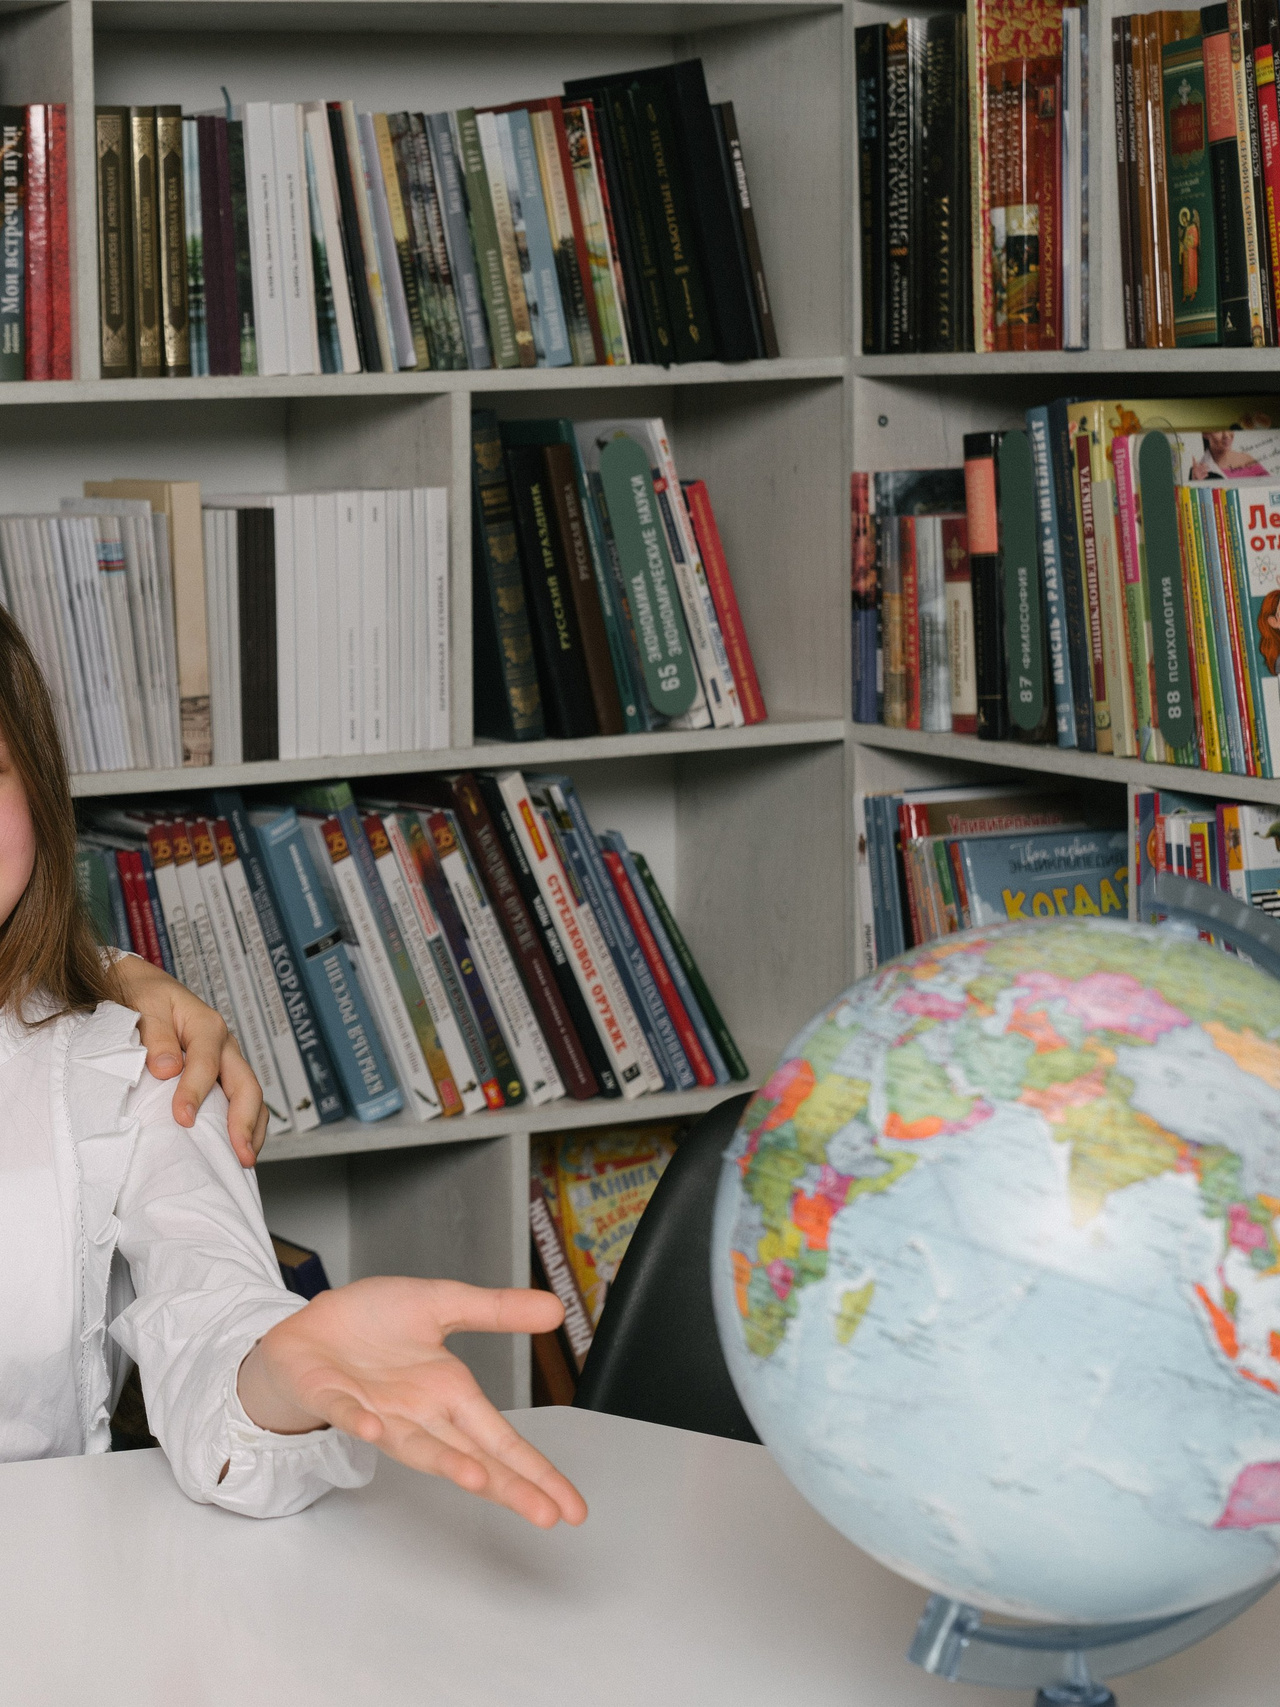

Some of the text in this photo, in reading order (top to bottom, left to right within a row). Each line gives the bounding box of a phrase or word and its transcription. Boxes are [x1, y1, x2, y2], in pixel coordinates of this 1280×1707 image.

[1114, 63, 1125, 162] МОНАСТЫРИ РОССИИ
[1205, 50, 1220, 126] РУССКИЕ
[1218, 52, 1231, 119] СВЯТЫЕ
[1245, 53, 1259, 177] ИСТОРИЯ ХРИСТИАНСТВА
[1261, 104, 1272, 167] КОЗЫРЕВА
[1269, 120, 1277, 146] АННА
[2, 125, 22, 171] пути
[3, 175, 18, 186] в
[896, 66, 909, 242] ЭНЦИКЛОПЕДИЯ
[3, 191, 23, 268] встречи
[1240, 140, 1257, 266] СЕРАФИМ САРОВСКИЙ
[1266, 185, 1278, 266] КРЕЩЕНИЯ
[0, 273, 19, 314] Мои
[1042, 206, 1053, 316] ПРАВОСЛАВИЯ
[1113, 448, 1128, 505] Правила
[530, 484, 571, 649] РУССКИЙ ПРАЗДНИК
[569, 520, 590, 580] РУССКАЯ
[629, 473, 683, 692] 65 ЭКОНОМИЧЕСКИЕ НАУКИ
[1031, 419, 1062, 684] МЫСЛЬ РАЗУМ ИНТЕЛЛЕКТ
[1079, 465, 1103, 661] ЭНЦИКЛОПЕДИЯ ЭТИКЕТА
[630, 568, 663, 663] ЭКОНОМИКА.
[1016, 567, 1033, 703] 87 ФИЛОСОФИЯ
[1160, 576, 1181, 719] 88 ПСИХОЛОГИЯ
[266, 944, 322, 1049] КОРАБЛИ
[544, 876, 599, 980] СТРЕЛКОВОЕ
[588, 982, 629, 1054] ОРУЖИЕ
[322, 954, 385, 1096] КРЫЛЬЯ РОССИИ
[588, 1165, 660, 1201] КНИГА
[530, 1196, 595, 1356] ЖУРНАЛИСТИКА
